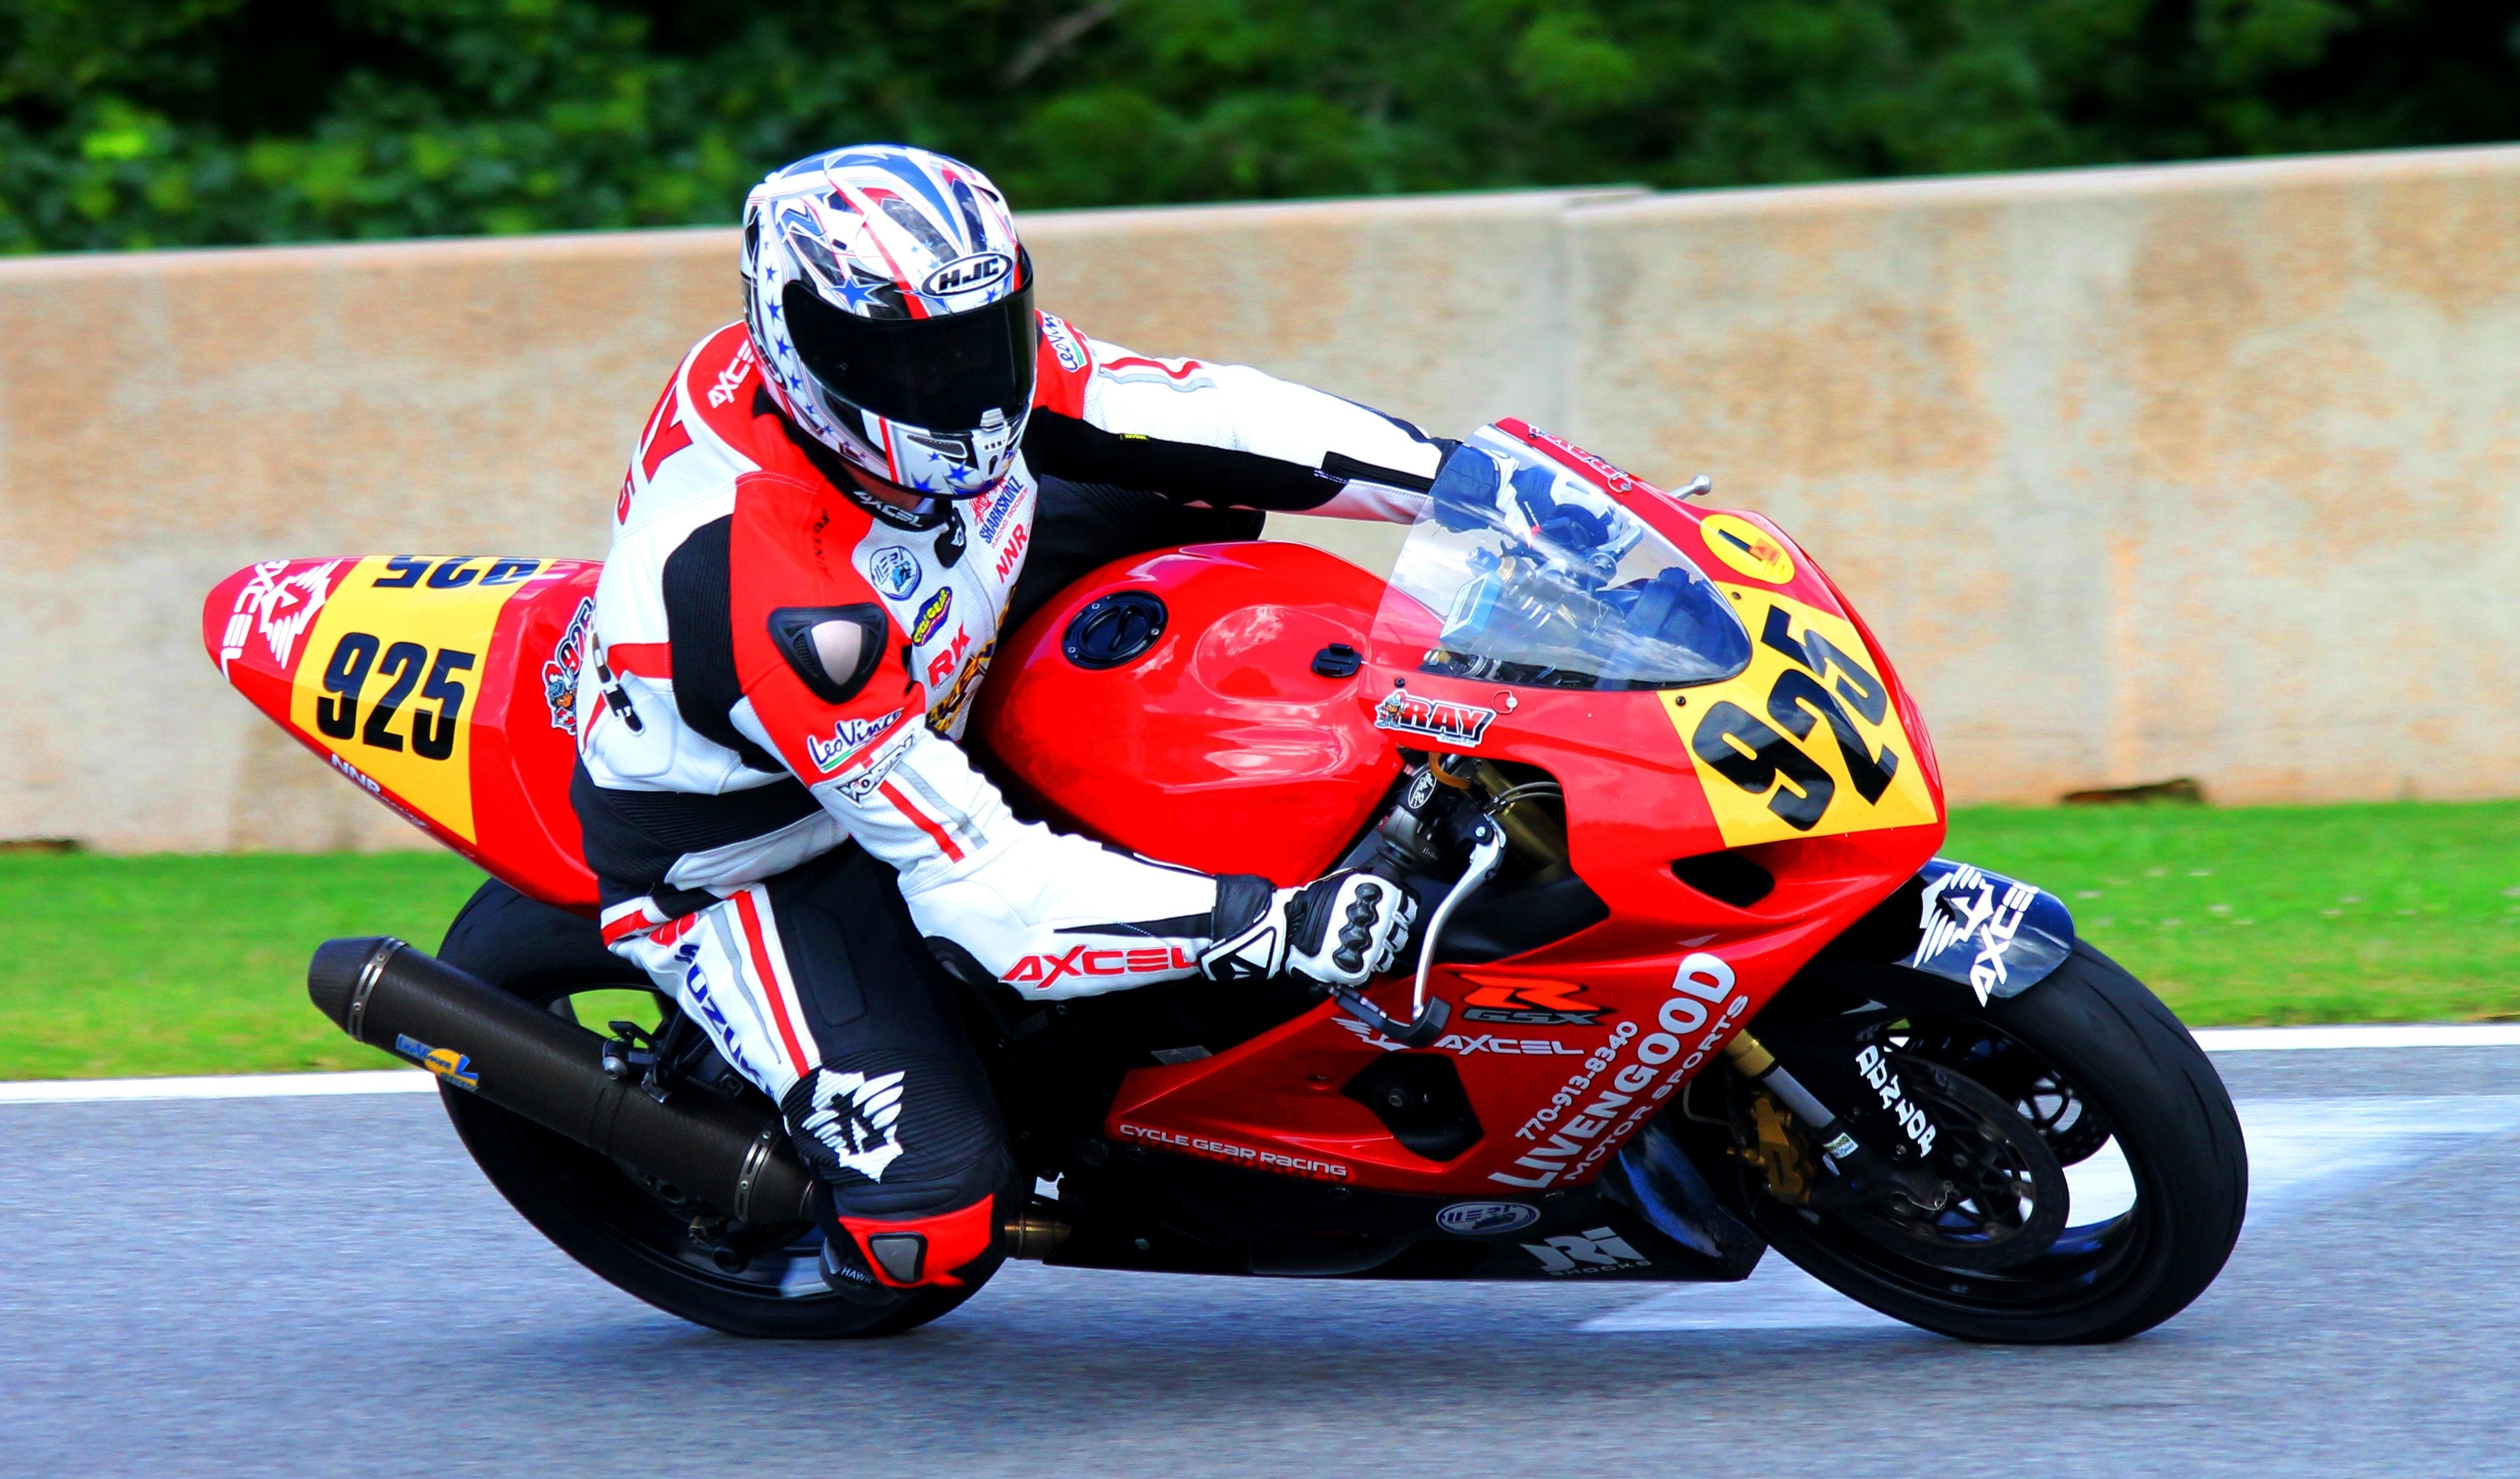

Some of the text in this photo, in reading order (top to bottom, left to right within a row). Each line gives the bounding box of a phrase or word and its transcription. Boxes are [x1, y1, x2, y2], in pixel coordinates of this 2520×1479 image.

[939, 257, 999, 291] HJC
[708, 339, 755, 409] AXCE
[979, 475, 1024, 545] SHARKSKINZ
[996, 523, 1028, 585] NNR
[927, 620, 972, 689] RK
[315, 632, 476, 761] 925
[1399, 700, 1489, 739] RAY
[1691, 604, 1900, 832] 925
[809, 710, 901, 765] LeoVince
[998, 945, 1199, 989] AXCEL
[1433, 1034, 1585, 1055] AXCEL
[1463, 1008, 1602, 1026] GSX
[1487, 952, 1736, 1189] LIVENGOOD
[1515, 1021, 1638, 1141] 770-913-8340
[1563, 995, 1749, 1181] MOTOR SPORTS
[1855, 1045, 1937, 1159] DUNLOP
[1120, 1124, 1189, 1146] CYCLE
